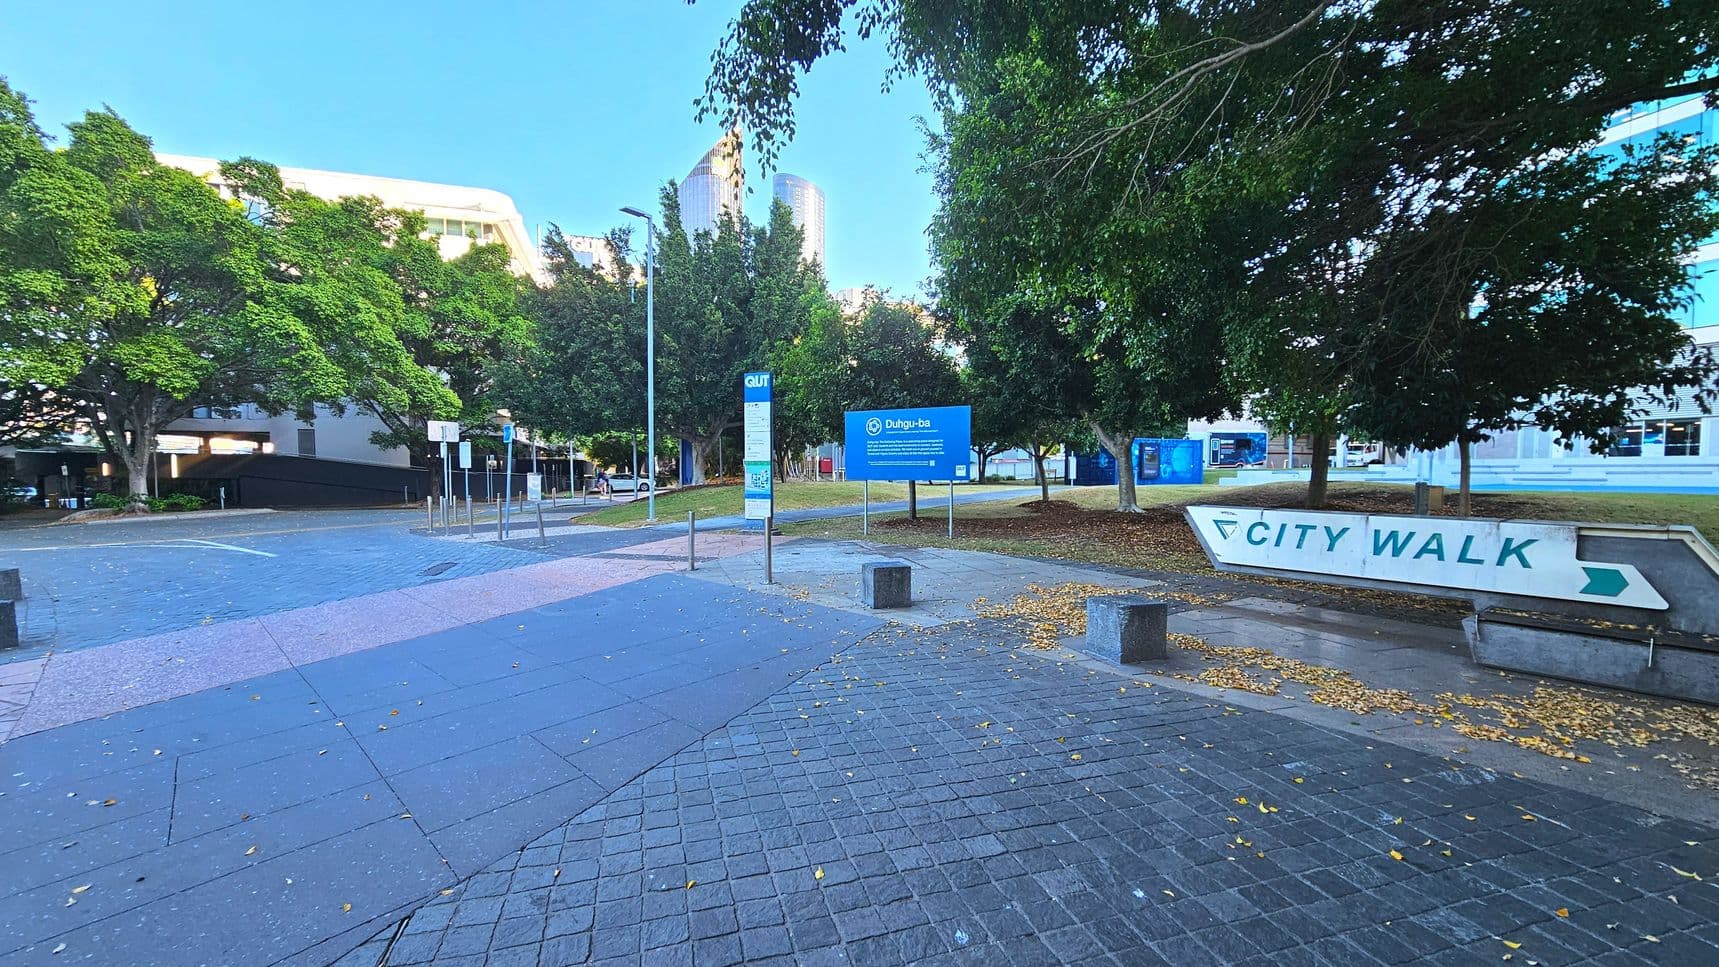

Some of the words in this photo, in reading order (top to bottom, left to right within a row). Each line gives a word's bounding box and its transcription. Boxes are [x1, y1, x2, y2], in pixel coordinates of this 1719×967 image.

[745, 374, 769, 388] QUT
[885, 418, 931, 430] Duhgu-ba
[1246, 521, 1351, 552] CITY
[1372, 528, 1539, 569] WALK
